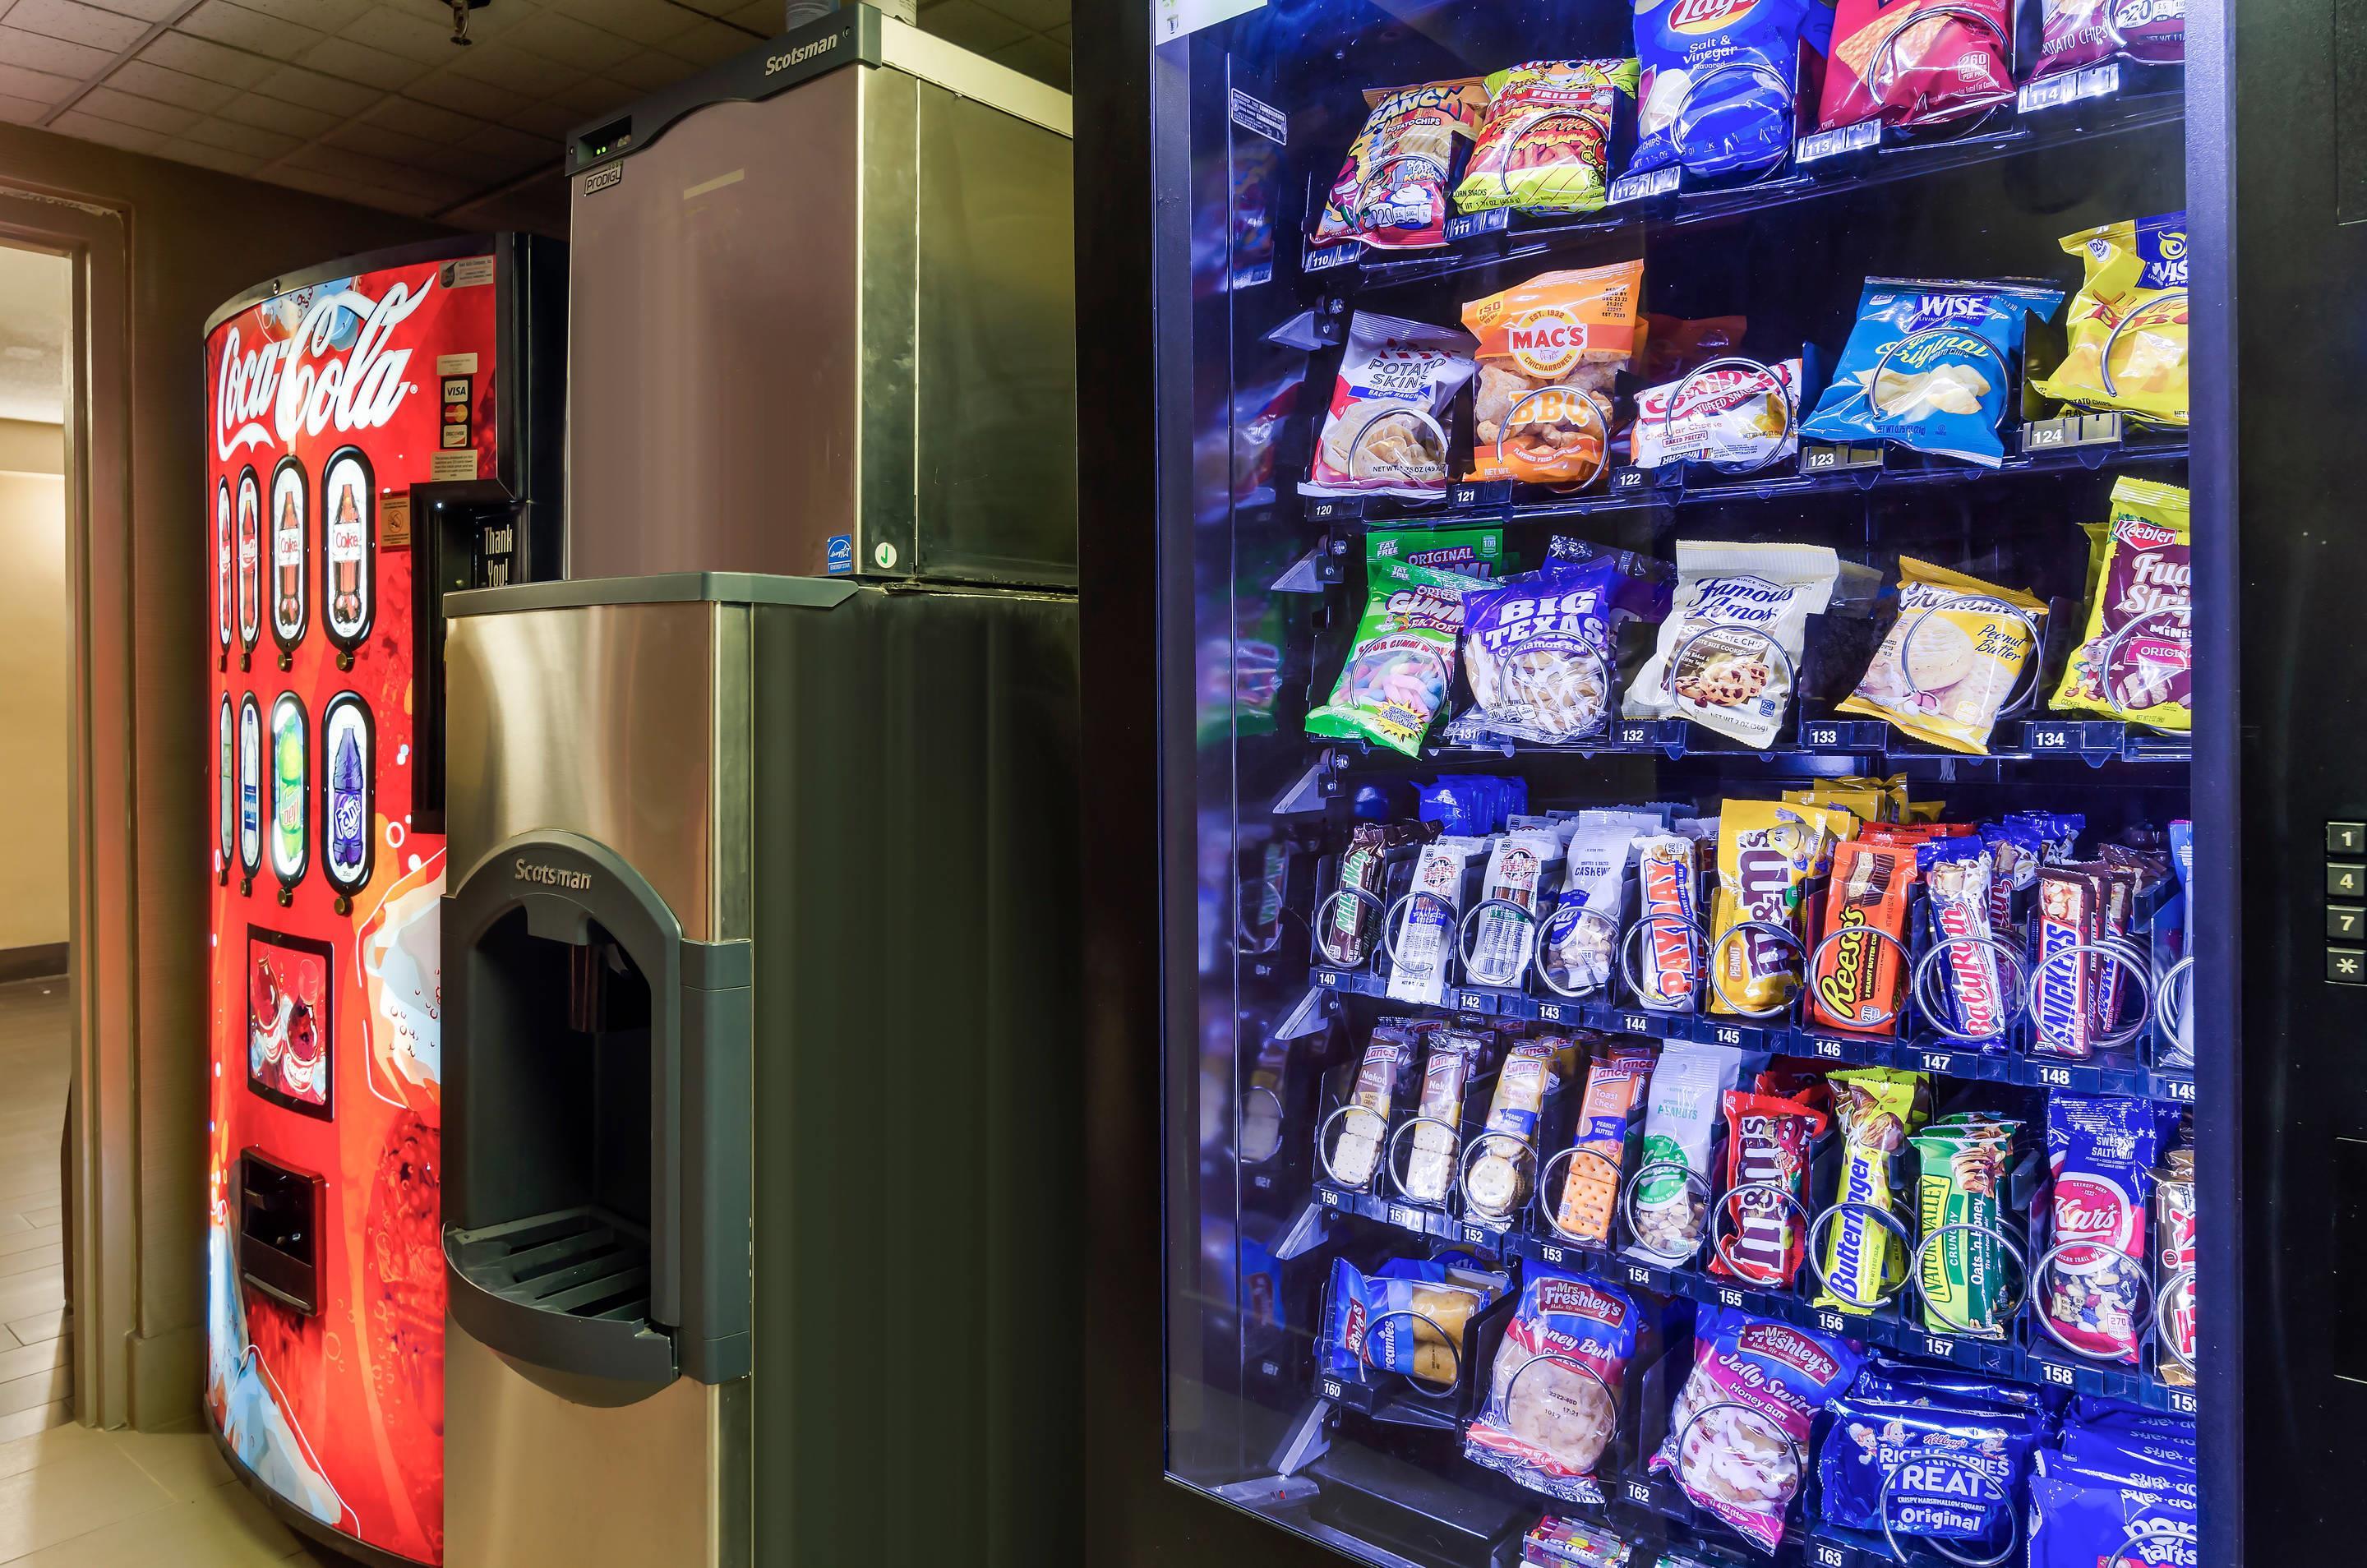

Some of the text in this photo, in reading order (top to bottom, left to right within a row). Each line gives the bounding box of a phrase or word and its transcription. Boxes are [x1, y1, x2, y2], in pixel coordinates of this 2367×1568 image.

[1689, 35, 1731, 53] Salt &
[2042, 25, 2108, 56] POTATO CHIPS
[765, 33, 837, 76] Scotsman
[1531, 90, 1579, 99] FRIES
[2031, 90, 2059, 104] 114
[1387, 117, 1441, 133] POTATO CHIPS
[1821, 119, 1835, 130] CHIPS
[1642, 137, 1661, 150] CHIPS
[1807, 141, 1830, 153] 113
[1617, 185, 1636, 197] 112
[1454, 223, 1470, 235] 111
[2090, 239, 2103, 252] 120
[1313, 256, 1329, 267] 110
[1922, 296, 1985, 316] WISE
[1529, 309, 1565, 323] EST. 1932
[1512, 326, 1585, 349] MAC'S
[1875, 334, 1989, 369] Original
[217, 272, 436, 462] Coca-Cola
[1368, 357, 1446, 376] POTATO
[1524, 353, 1573, 371] CHICHARRONES
[447, 386, 466, 396] VISA
[1508, 390, 1590, 427] BBQ
[1693, 396, 1727, 415] STUFFED
[1664, 437, 1683, 445] BAKED
[2033, 429, 2062, 444] 124
[1810, 454, 1834, 466] 123
[1620, 473, 1641, 486] 122
[1457, 491, 1474, 502] 121
[1316, 505, 1332, 515] 120
[336, 533, 358, 548] Coke
[484, 523, 513, 556] Thank
[2118, 522, 2176, 544] Keebler
[281, 537, 298, 553] Coke
[1377, 547, 1398, 557] FREE
[1379, 542, 1396, 550] FAT
[1408, 547, 1474, 565] ORIGINAL
[487, 558, 509, 588] You!
[1686, 577, 1795, 607] Famous
[1499, 591, 1597, 626] BIG
[1684, 597, 1777, 622] Amos
[1485, 614, 1603, 653] TEXAS
[1977, 624, 2028, 648] Peanut
[1389, 639, 1420, 648] GUMMI
[1974, 640, 2021, 662] Butter
[2060, 698, 2080, 708] COOKIES
[1382, 710, 1396, 722] SOUR
[1460, 729, 1477, 739] 131
[1622, 730, 1643, 741] 132
[1811, 731, 1837, 743] 133
[2035, 733, 2065, 746] 134
[2342, 832, 2351, 846] 1
[514, 858, 592, 889] Scotsman
[1343, 850, 1369, 888] Way
[2340, 874, 2354, 888] 4
[1646, 860, 1694, 995] PAYDAY
[2340, 916, 2354, 930] 7
[1729, 946, 1741, 977] PEANUT
[1820, 906, 1865, 1018] Reese's
[1319, 973, 1336, 985] 140
[1865, 971, 1873, 991] PEANUT
[2044, 924, 2076, 1046] SNICKERS
[1461, 995, 1479, 1008] 142
[1540, 1007, 1560, 1019] 143
[1863, 1008, 1871, 1020] 210
[1625, 1017, 1646, 1031] 144
[1717, 1028, 1740, 1043] 145
[1366, 1046, 1397, 1058] Lance
[1816, 1040, 1841, 1057] 146
[1922, 1055, 1950, 1070] 147
[1594, 1068, 1629, 1079] Lance
[2040, 1068, 2070, 1085] 148
[1595, 1088, 1618, 1100] Toast
[1594, 1098, 1615, 1109] Chee
[1658, 1105, 1698, 1120] PEANUTS
[1596, 1120, 1617, 1129] PEANUT
[1594, 1128, 1614, 1137] BUTTER
[2092, 1147, 2116, 1158] SALTY
[1321, 1192, 1338, 1205] 150
[1922, 1178, 1946, 1234] VALLEY
[1390, 1209, 1406, 1221] 151
[2055, 1195, 2119, 1231] Kar's
[1829, 1155, 1873, 1300] Butterfinger
[1465, 1229, 1483, 1243] 152
[1949, 1211, 1959, 1266] CRUNCHY
[1971, 1198, 1986, 1285] Oats Honey
[1542, 1247, 1562, 1261] 153
[2074, 1255, 2090, 1263] TRAIL
[1628, 1267, 1650, 1282] 154
[1557, 1282, 1579, 1294] Mrs.
[1545, 1287, 1622, 1317] Freshley's
[1719, 1290, 1742, 1307] 155
[1818, 1313, 1844, 1331] 156
[2110, 1317, 2126, 1327] 270
[1764, 1326, 1788, 1339] Mrs.
[1580, 1338, 1616, 1361] Bun
[1748, 1330, 1834, 1374] Freshley's
[1751, 1342, 1768, 1351] Make
[1778, 1351, 1804, 1366] sweeter!
[1926, 1339, 1954, 1355] 157
[2043, 1365, 2073, 1384] 158
[1323, 1382, 1340, 1397] 160
[1719, 1354, 1823, 1417] Jelly Swirl
[1729, 1382, 1788, 1423] Honey Bun
[1486, 1414, 1498, 1427] 470
[1923, 1433, 1968, 1449] Kellogg's
[1880, 1448, 1921, 1464] RICE
[1882, 1464, 2004, 1500] TREATS
[1628, 1485, 1650, 1502] 162
[1918, 1497, 1960, 1508] MARSHMALLOW
[1961, 1502, 1986, 1512] SQUARES
[1901, 1507, 1981, 1531] Original
[1817, 1547, 1842, 1566] 163
[2139, 1543, 2196, 1566] tarts
